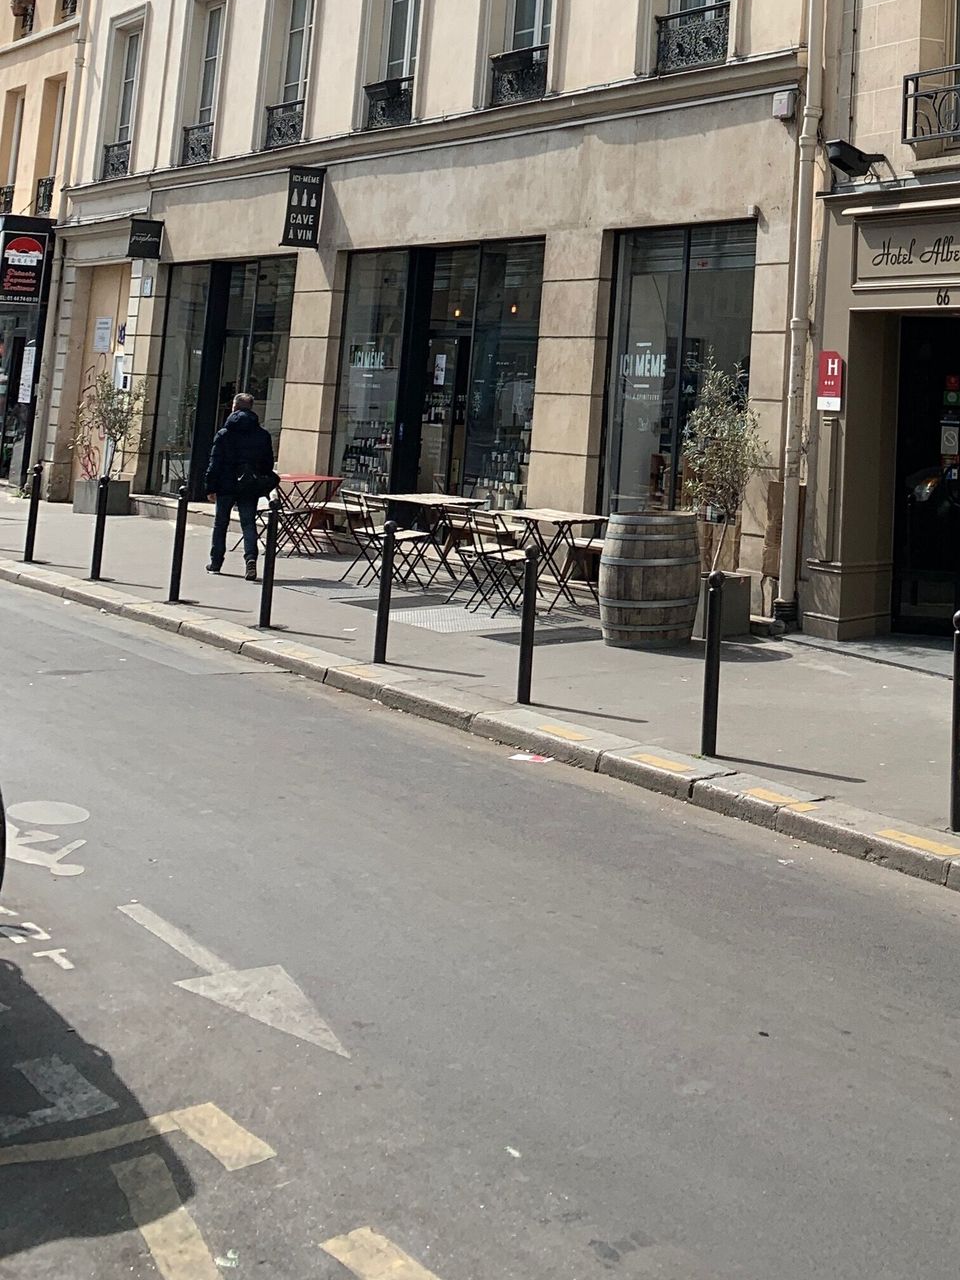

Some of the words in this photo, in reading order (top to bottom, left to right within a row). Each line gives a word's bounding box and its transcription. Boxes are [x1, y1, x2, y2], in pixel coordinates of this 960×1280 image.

[290, 213, 314, 225] CAVE
[297, 229, 313, 241] VIN
[872, 236, 916, 267] Hotel
[919, 235, 960, 266] Albe
[936, 289, 951, 305] 66
[619, 353, 633, 377] ICI
[635, 349, 667, 377] MÊME
[827, 358, 839, 376] H
